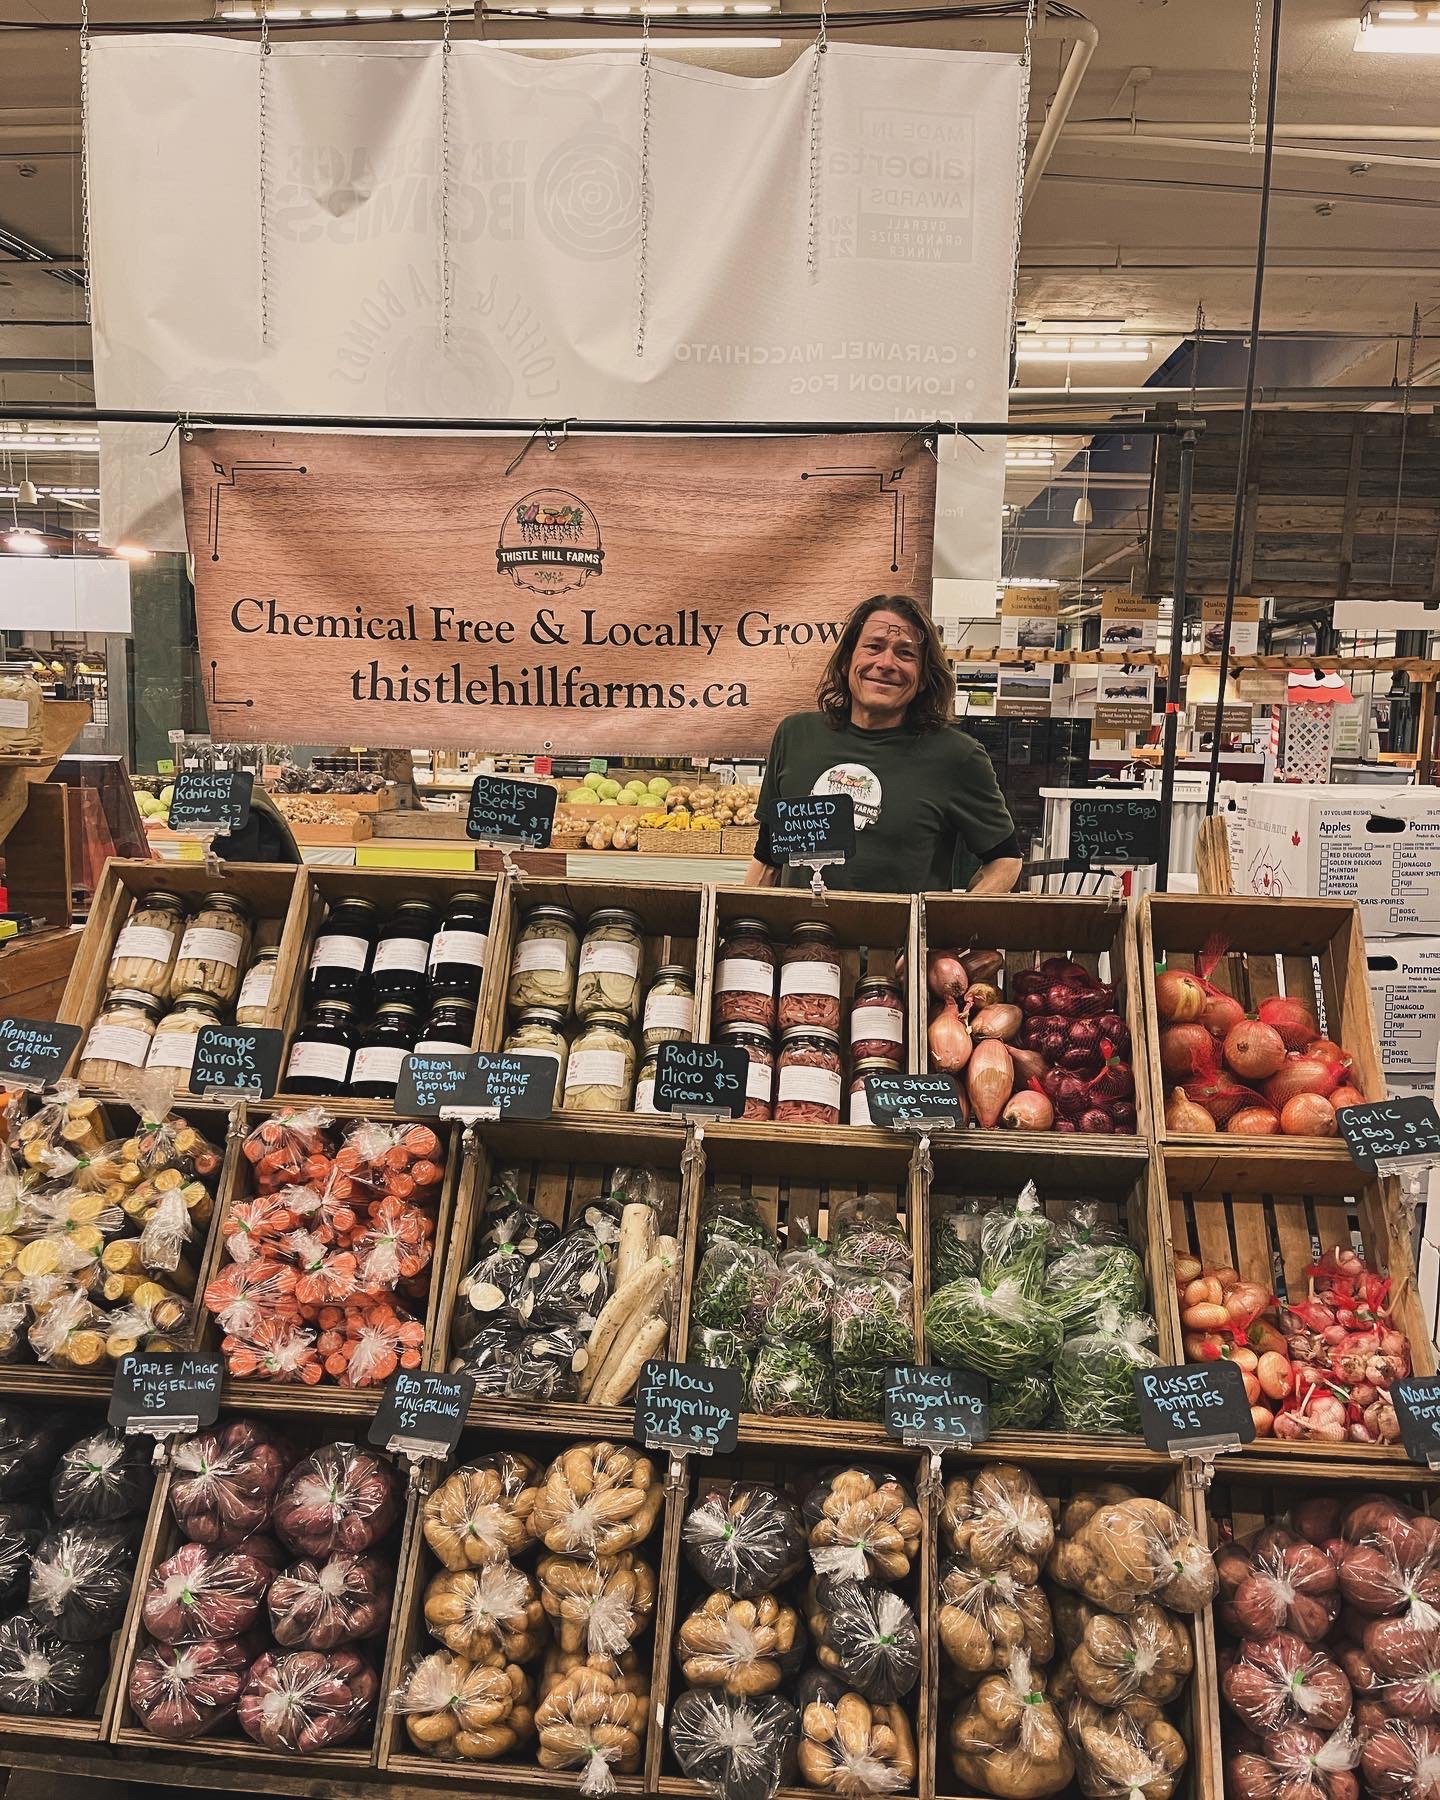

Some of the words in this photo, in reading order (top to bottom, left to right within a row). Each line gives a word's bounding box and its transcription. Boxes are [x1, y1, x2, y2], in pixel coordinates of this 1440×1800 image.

[500, 550, 539, 563] THISTLE
[542, 550, 563, 561] HILL
[566, 551, 600, 564] FARMS
[231, 598, 419, 641] Chemical
[429, 606, 515, 643] Free
[530, 608, 569, 645] &
[581, 609, 724, 655] Locally
[737, 611, 849, 646] Grow
[350, 660, 750, 709] thistlehillfarms.ca
[479, 778, 538, 799] Pickled
[477, 791, 526, 810] Beets
[776, 801, 836, 818] PICKLED
[854, 803, 879, 817] FARMS
[784, 818, 831, 832] ONIONS
[1075, 814, 1099, 827] $5
[1319, 821, 1351, 834] Apples
[1409, 821, 1440, 832] Pomm
[1401, 861, 1432, 869] JONAGOLD
[1401, 963, 1440, 974] Pommes
[1393, 1003, 1425, 1011] JONAGOLD
[0, 1019, 53, 1043] RAINBOW
[7, 1040, 61, 1058] CARROTS
[202, 1030, 256, 1056] Orange
[9, 1055, 31, 1069] $6
[198, 1047, 256, 1069] Carrots
[409, 1056, 452, 1070] DAIKON
[665, 1045, 724, 1069] Radish
[196, 1068, 226, 1085] 2LB
[234, 1071, 262, 1089] $5
[412, 1071, 443, 1081] NERO
[487, 1072, 531, 1085] ALPINE
[662, 1066, 703, 1084] Micro
[714, 1073, 739, 1090] $5
[870, 1077, 900, 1089] Pea
[903, 1079, 951, 1091] Shoots
[416, 1081, 456, 1091] RADISH
[486, 1084, 526, 1095] RADISH
[660, 1084, 714, 1103] Greens
[416, 1092, 436, 1106] $5
[492, 1095, 511, 1108] $5
[877, 1092, 917, 1105] Micro
[920, 1093, 958, 1105] Greens
[898, 1107, 924, 1120] $5
[1342, 1109, 1401, 1125] Garlic
[1348, 1130, 1362, 1141] 1
[1362, 1127, 1395, 1140] Bag
[1404, 1118, 1433, 1133] $4
[1356, 1145, 1367, 1156] 2
[1370, 1140, 1410, 1155] Bags
[1415, 1135, 1440, 1149] $7
[123, 1357, 174, 1376] PURPLE
[181, 1360, 219, 1375] MAGIC
[132, 1378, 216, 1391] FINGERLING
[395, 1374, 421, 1394] RED
[647, 1364, 714, 1393] Yellow
[895, 1367, 952, 1388] Mixed
[1143, 1371, 1209, 1398] RUSSET
[143, 1392, 166, 1408] $5
[394, 1396, 460, 1418] FINGERLING
[641, 1386, 734, 1430] Fingerling
[886, 1385, 987, 1414] Fingerling
[1153, 1390, 1224, 1413] POTATOES
[400, 1411, 418, 1428] $5
[643, 1412, 682, 1438] 3LB
[689, 1424, 719, 1445] $5
[891, 1411, 926, 1430] 3LB
[934, 1416, 966, 1437] $5
[1172, 1410, 1201, 1429] $5
